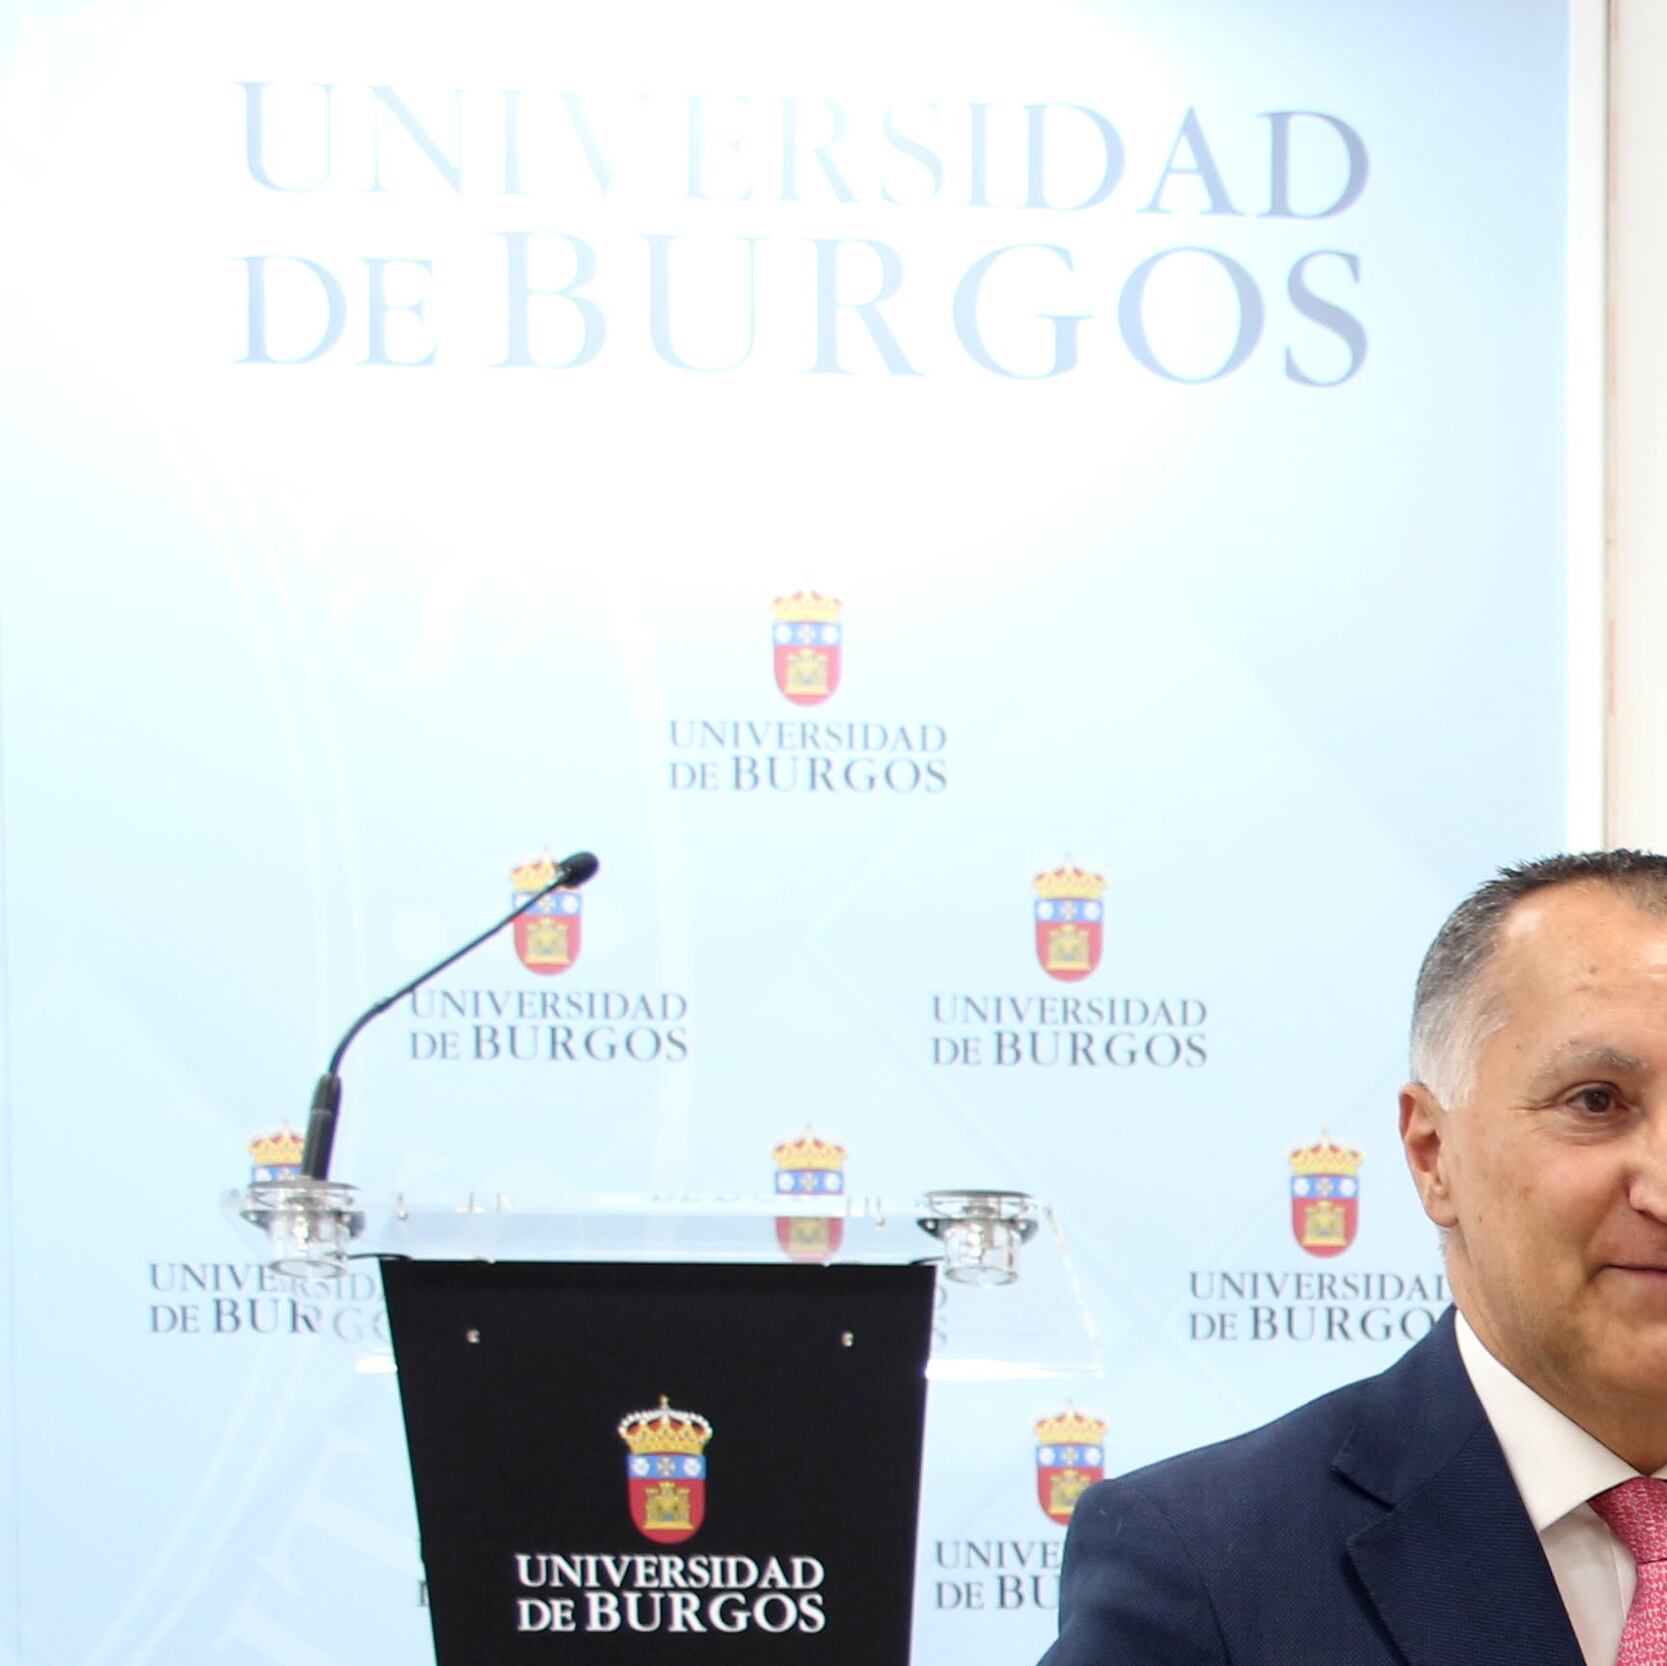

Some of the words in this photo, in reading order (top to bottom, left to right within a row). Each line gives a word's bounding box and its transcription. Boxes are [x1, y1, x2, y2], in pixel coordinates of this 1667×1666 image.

[234, 80, 1371, 222] UNIVERSIDAD
[232, 254, 438, 367] DE
[487, 229, 1371, 389] BURGOS
[668, 718, 949, 754] UNIVERSIDAD
[668, 759, 721, 793] DE
[728, 752, 949, 796] BURGOS
[410, 989, 687, 1022] UNIVERSIDAD
[932, 995, 1208, 1027] UNIVERSIDAD
[409, 1030, 461, 1061] DE
[472, 1024, 689, 1062] BURGOS
[931, 1036, 981, 1066] DE
[993, 1030, 1208, 1068] BURGOS
[149, 1304, 199, 1335] DE
[1188, 1310, 1239, 1341] DE
[1250, 1306, 1438, 1342] BURGO
[515, 1552, 825, 1590] UNIVERSIDAD
[935, 1540, 1061, 1569] UNIVE
[934, 1580, 984, 1611] DE
[996, 1575, 1060, 1611] BU
[516, 1598, 576, 1632] DE
[585, 1591, 826, 1634] BURGOS
